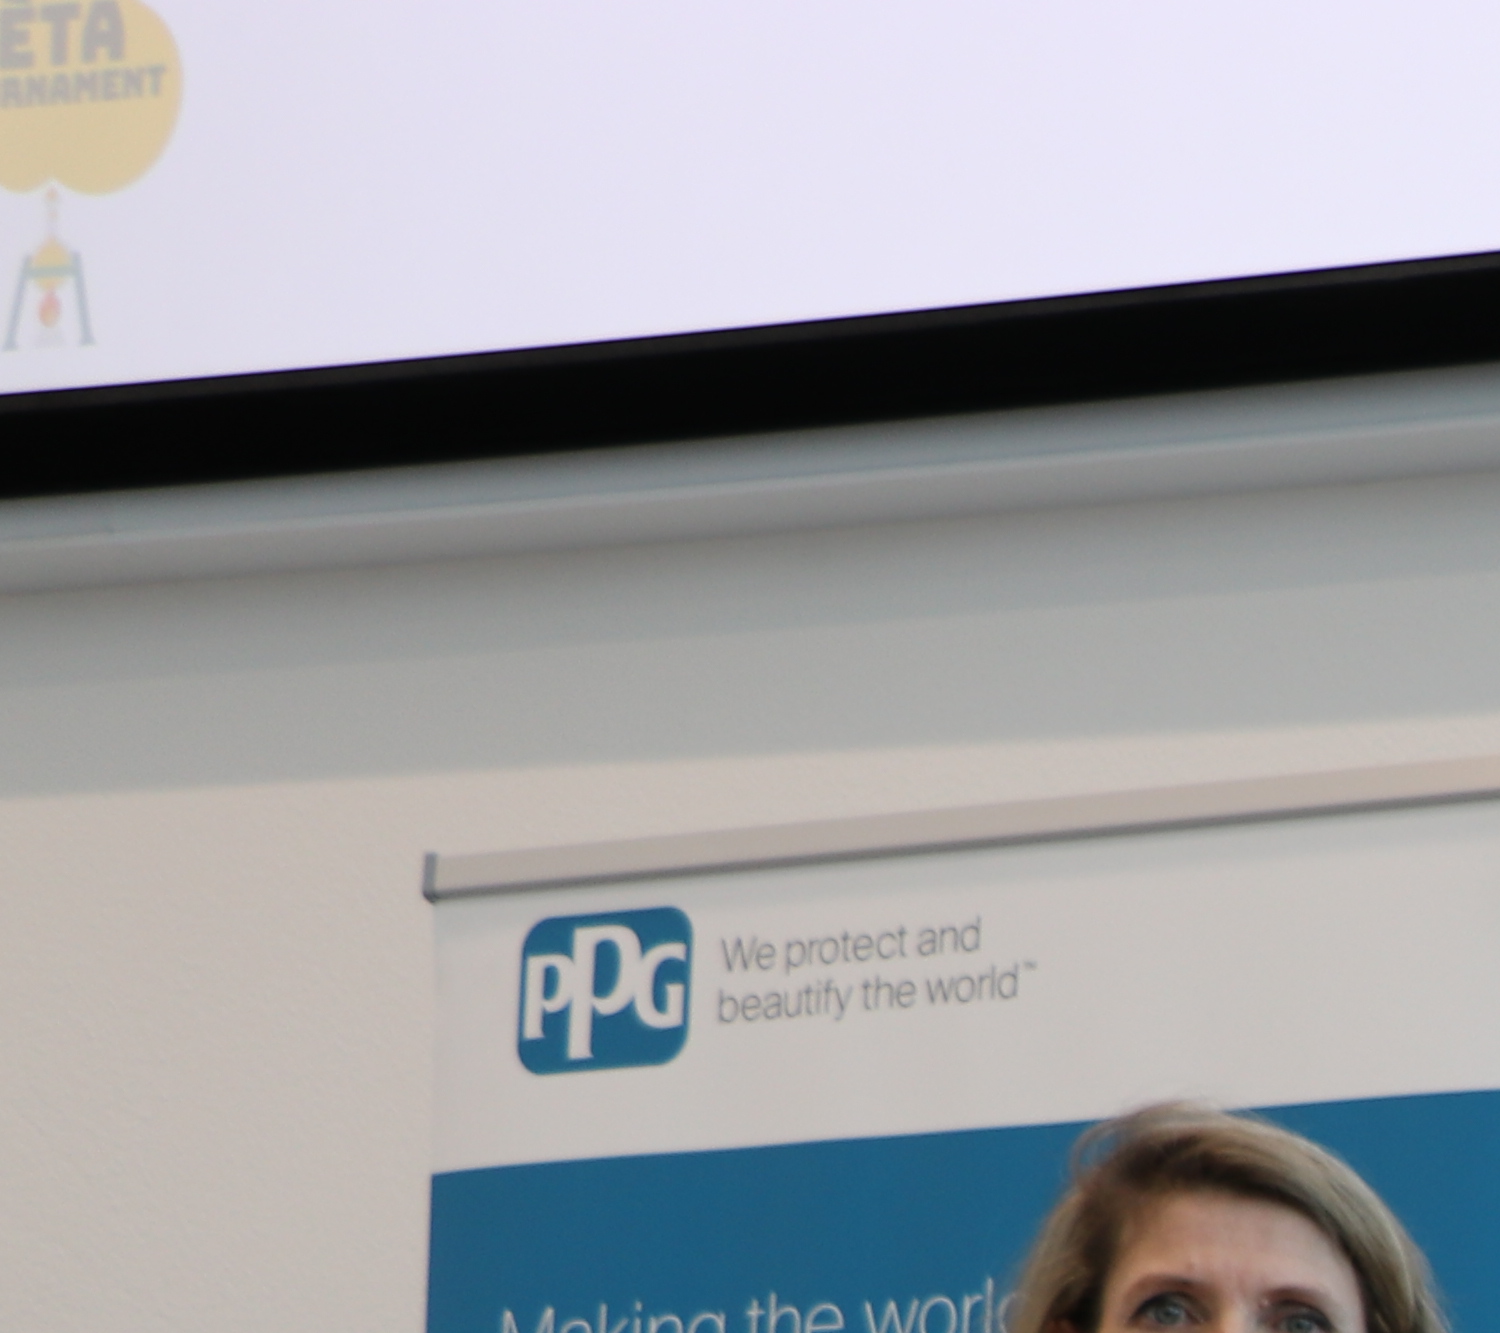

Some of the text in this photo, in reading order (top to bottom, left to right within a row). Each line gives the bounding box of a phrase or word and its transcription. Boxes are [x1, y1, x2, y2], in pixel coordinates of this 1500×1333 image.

[721, 915, 982, 974] We protect and
[522, 924, 687, 1060] PPG
[718, 979, 852, 1024] beautify
[863, 974, 917, 1013] the
